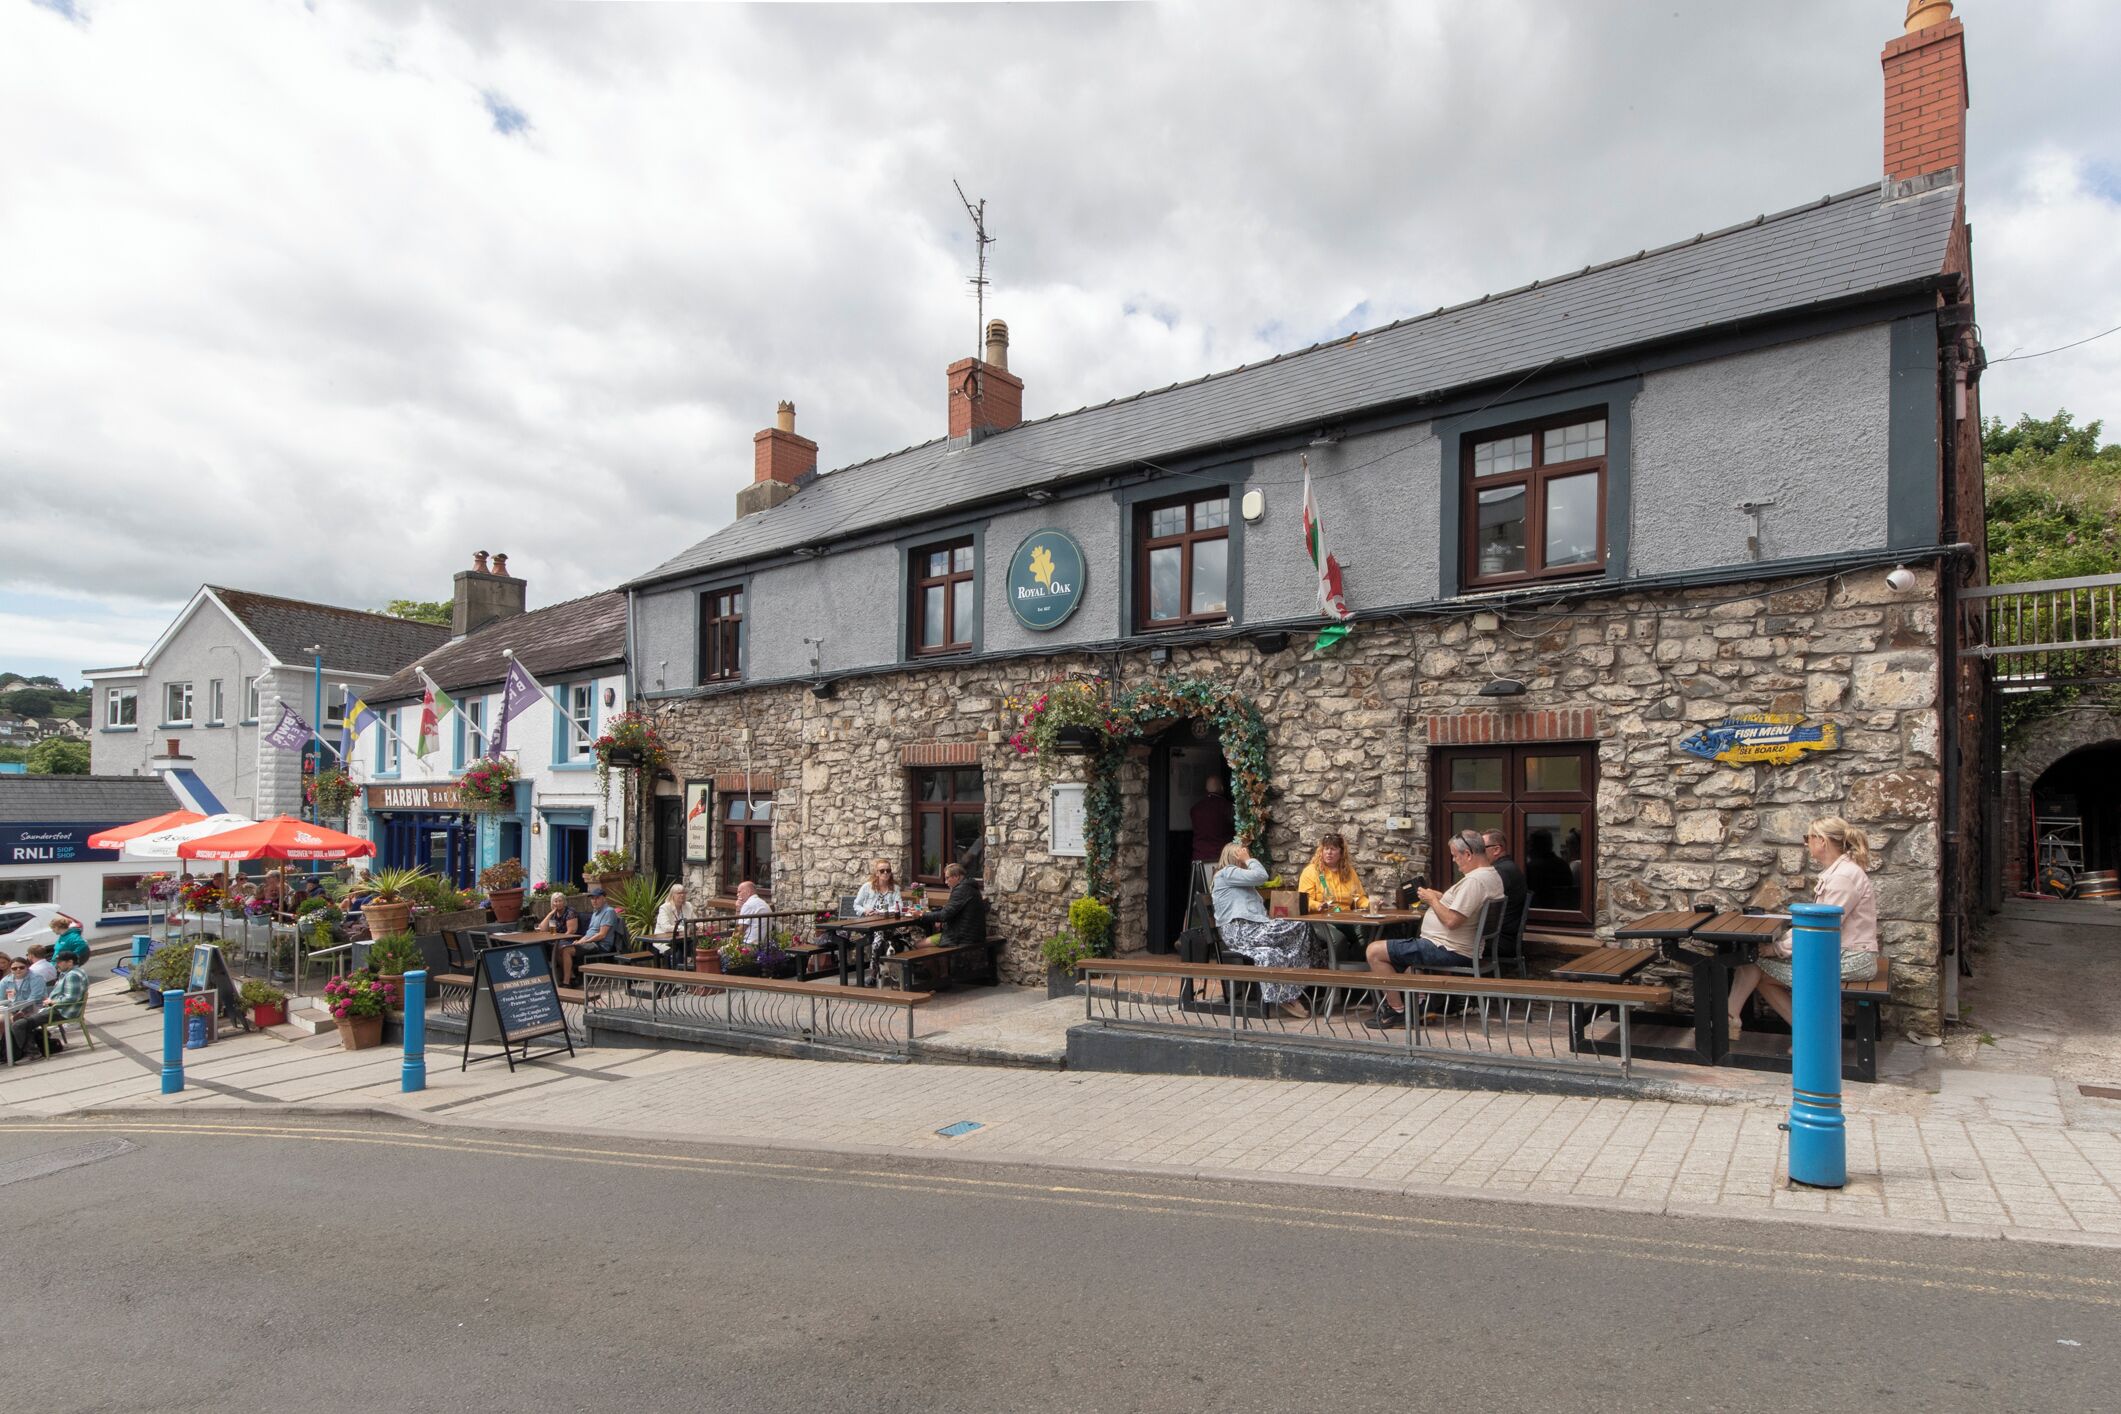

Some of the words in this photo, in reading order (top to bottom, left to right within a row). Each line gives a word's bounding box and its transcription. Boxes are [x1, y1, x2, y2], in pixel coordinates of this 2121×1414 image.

[1050, 581, 1071, 594] OAK
[1735, 729, 1757, 738] FISH
[1759, 725, 1793, 736] MENU
[1740, 746, 1751, 754] SEE
[1755, 745, 1785, 754] BOARD
[384, 788, 430, 807] HARBWR
[433, 792, 448, 803] BAR
[20, 831, 73, 841] Saundersfoot
[14, 847, 53, 859] RNLI
